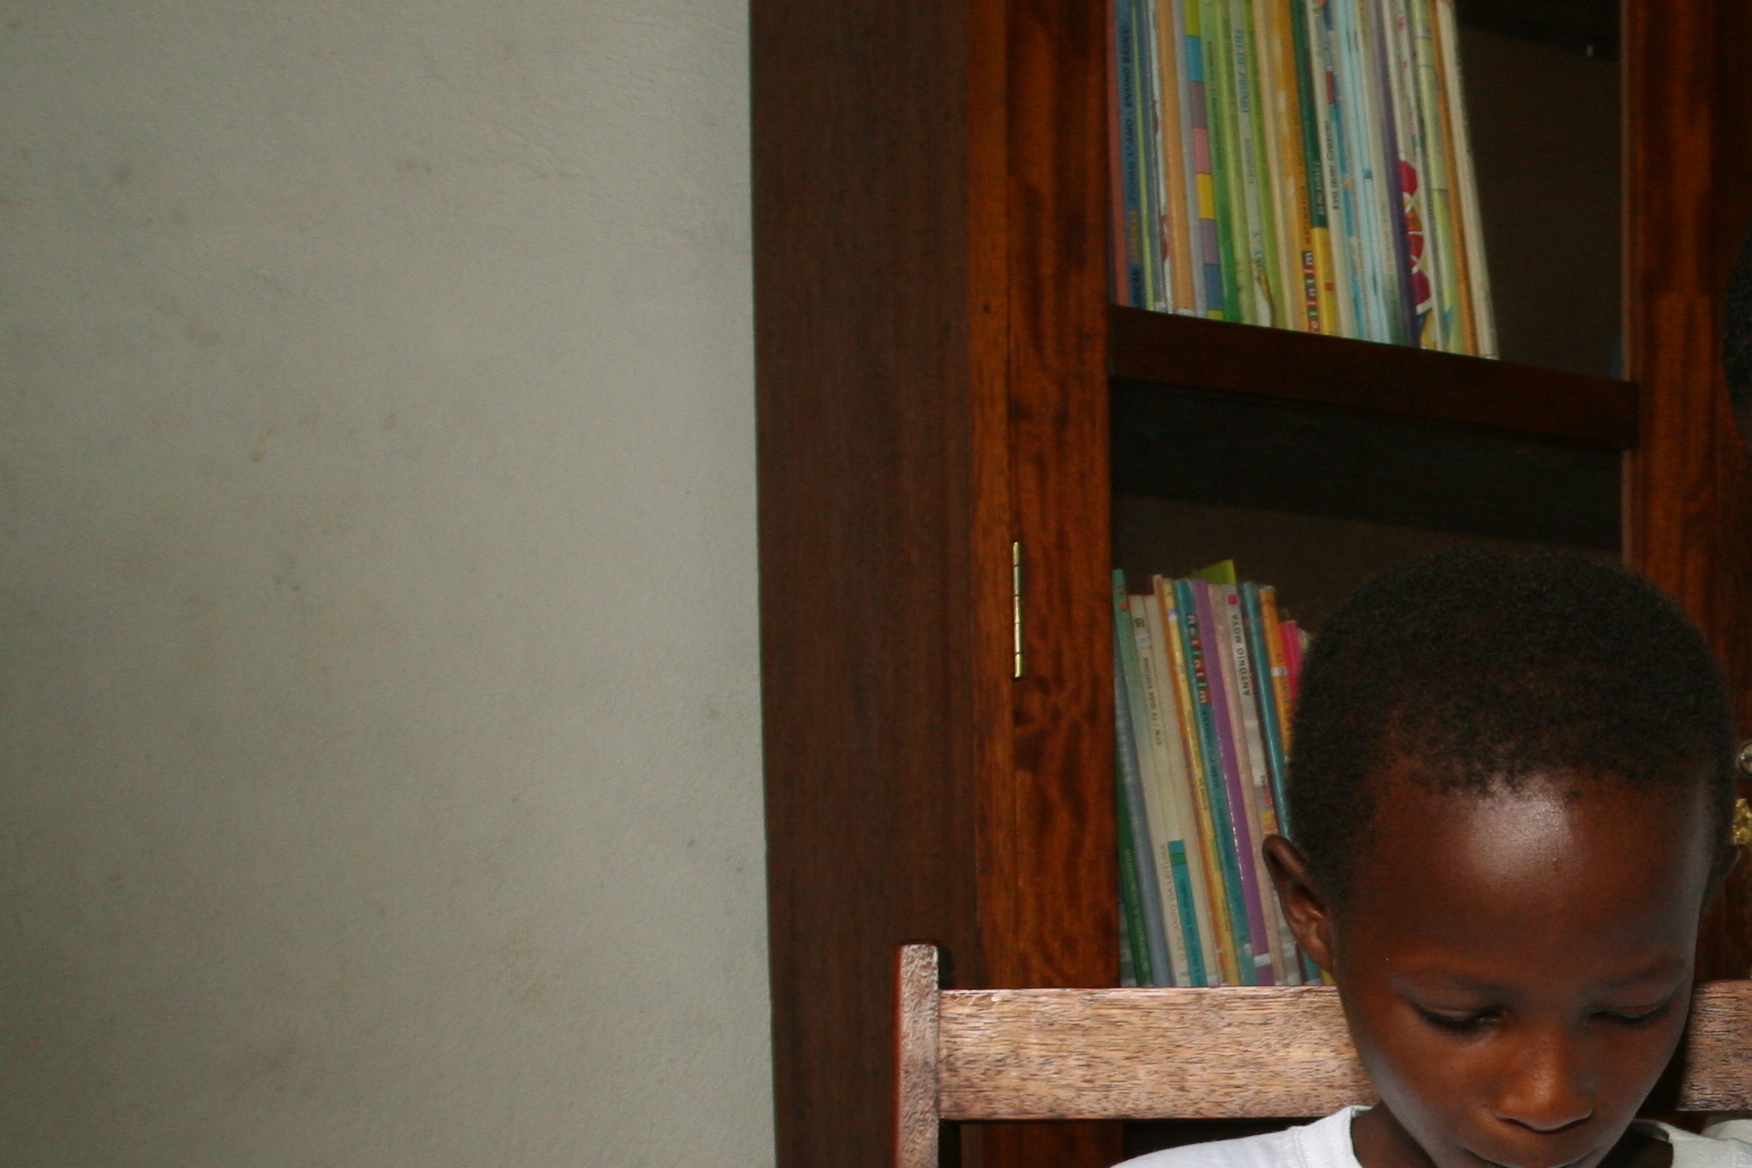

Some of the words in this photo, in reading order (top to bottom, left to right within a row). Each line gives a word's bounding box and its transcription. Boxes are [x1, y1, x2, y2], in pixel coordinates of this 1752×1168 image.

[1231, 613, 1242, 643] MOTA
[1183, 613, 1211, 705] Retintim
[1235, 647, 1250, 697] ANTÓNIO
